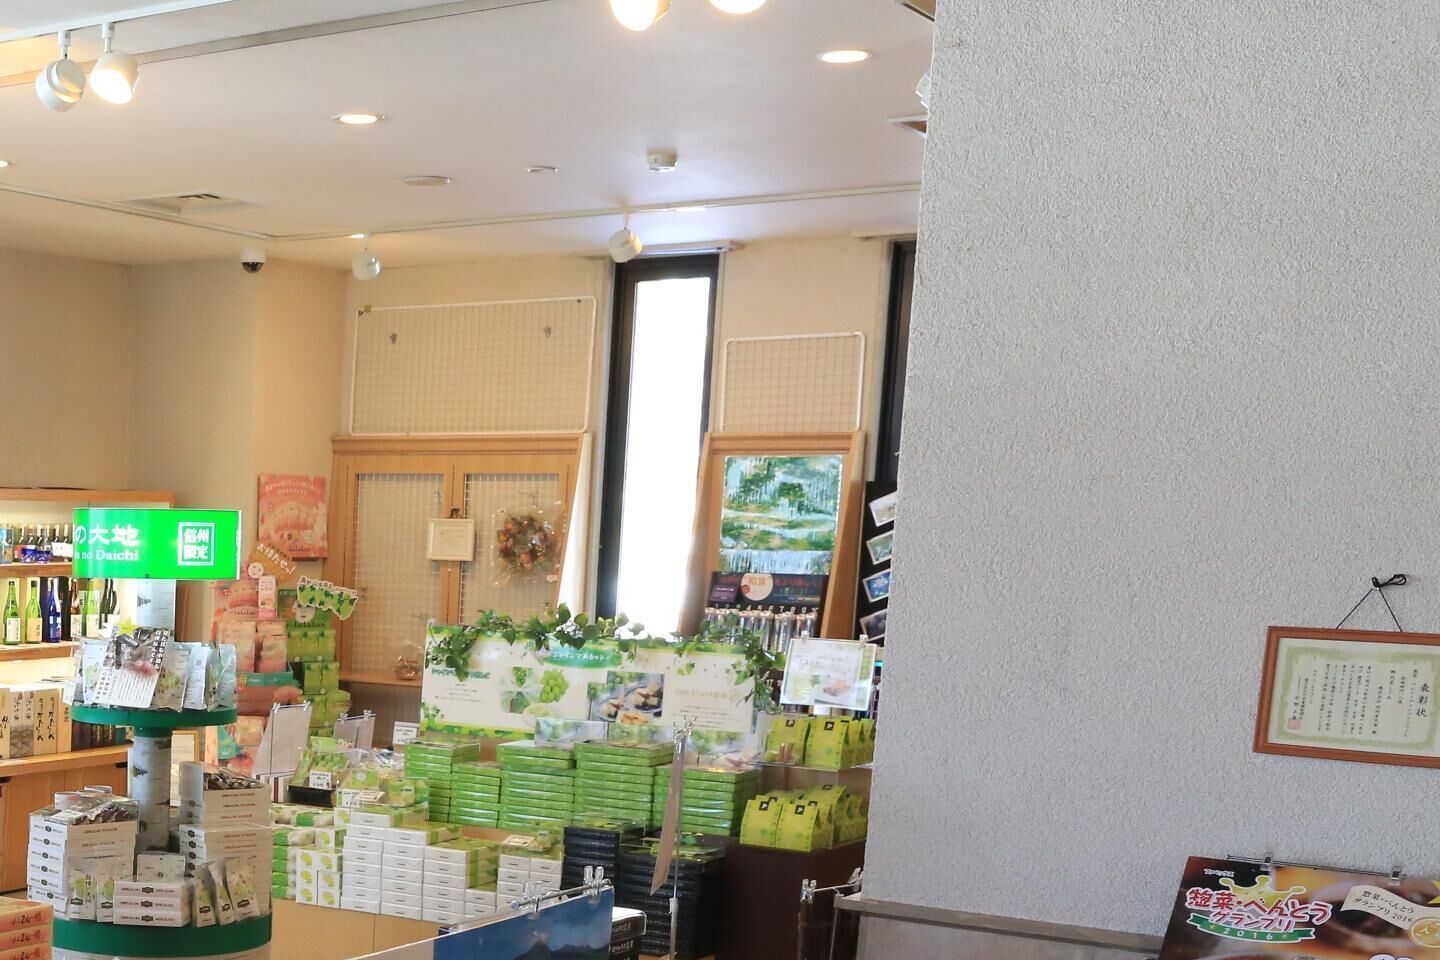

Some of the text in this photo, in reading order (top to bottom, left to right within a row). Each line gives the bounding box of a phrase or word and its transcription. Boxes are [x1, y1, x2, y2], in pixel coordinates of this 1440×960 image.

[184, 528, 209, 543] 信州
[96, 550, 139, 561] Daichi
[1416, 683, 1430, 717] 表彰状
[1186, 888, 1332, 925] 惣菜・べんとう
[1354, 898, 1413, 923] グランプリ 2016
[1212, 909, 1295, 931] グランプリ
[1223, 928, 1273, 940] 2016
